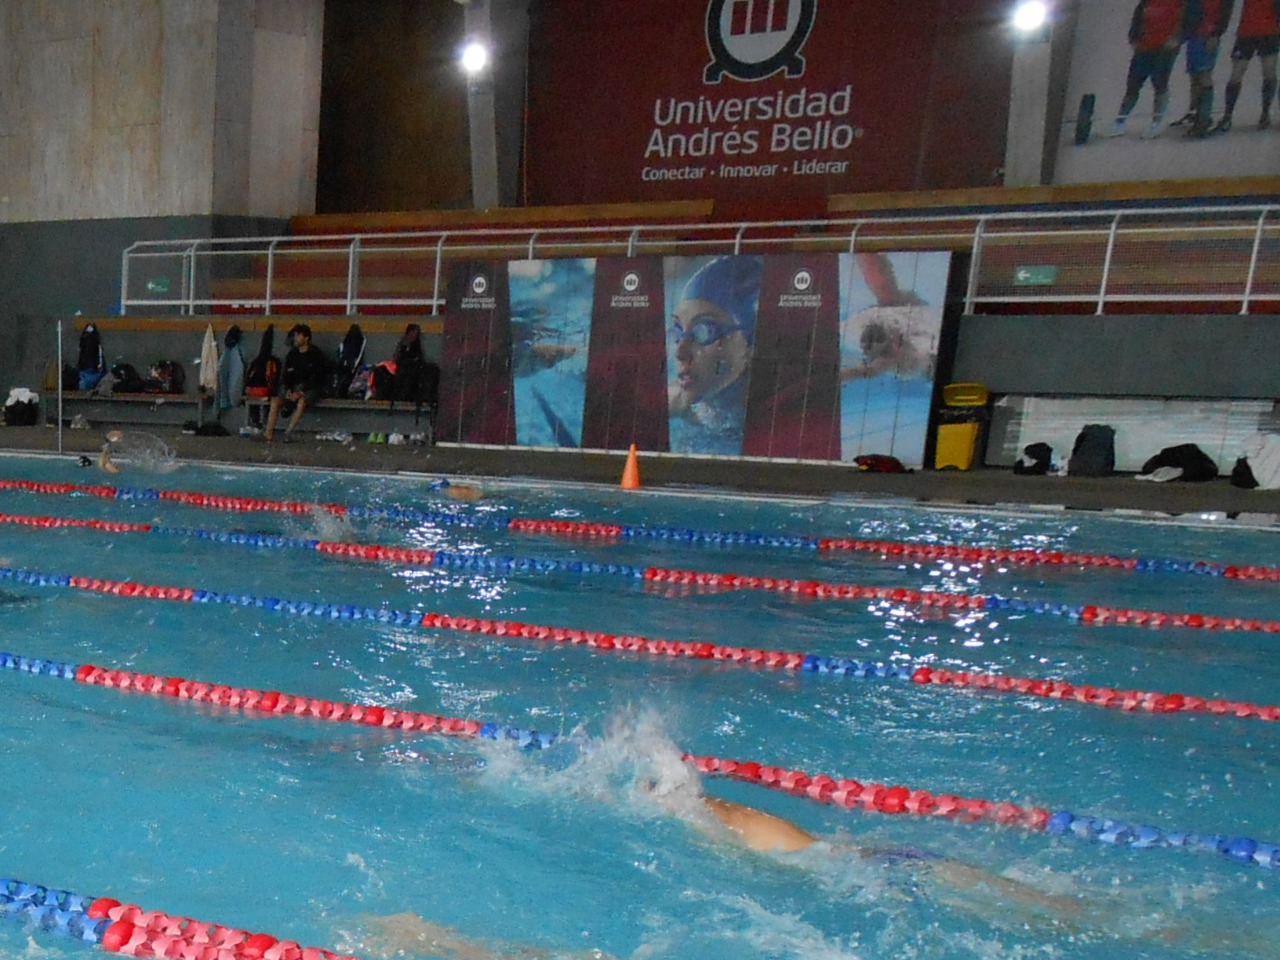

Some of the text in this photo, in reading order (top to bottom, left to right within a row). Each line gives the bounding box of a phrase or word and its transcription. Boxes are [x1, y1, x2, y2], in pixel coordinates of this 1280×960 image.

[654, 85, 852, 126] Universidad
[644, 120, 853, 158] Andrés Bello
[641, 159, 850, 181] Conectar Innovar Liderar
